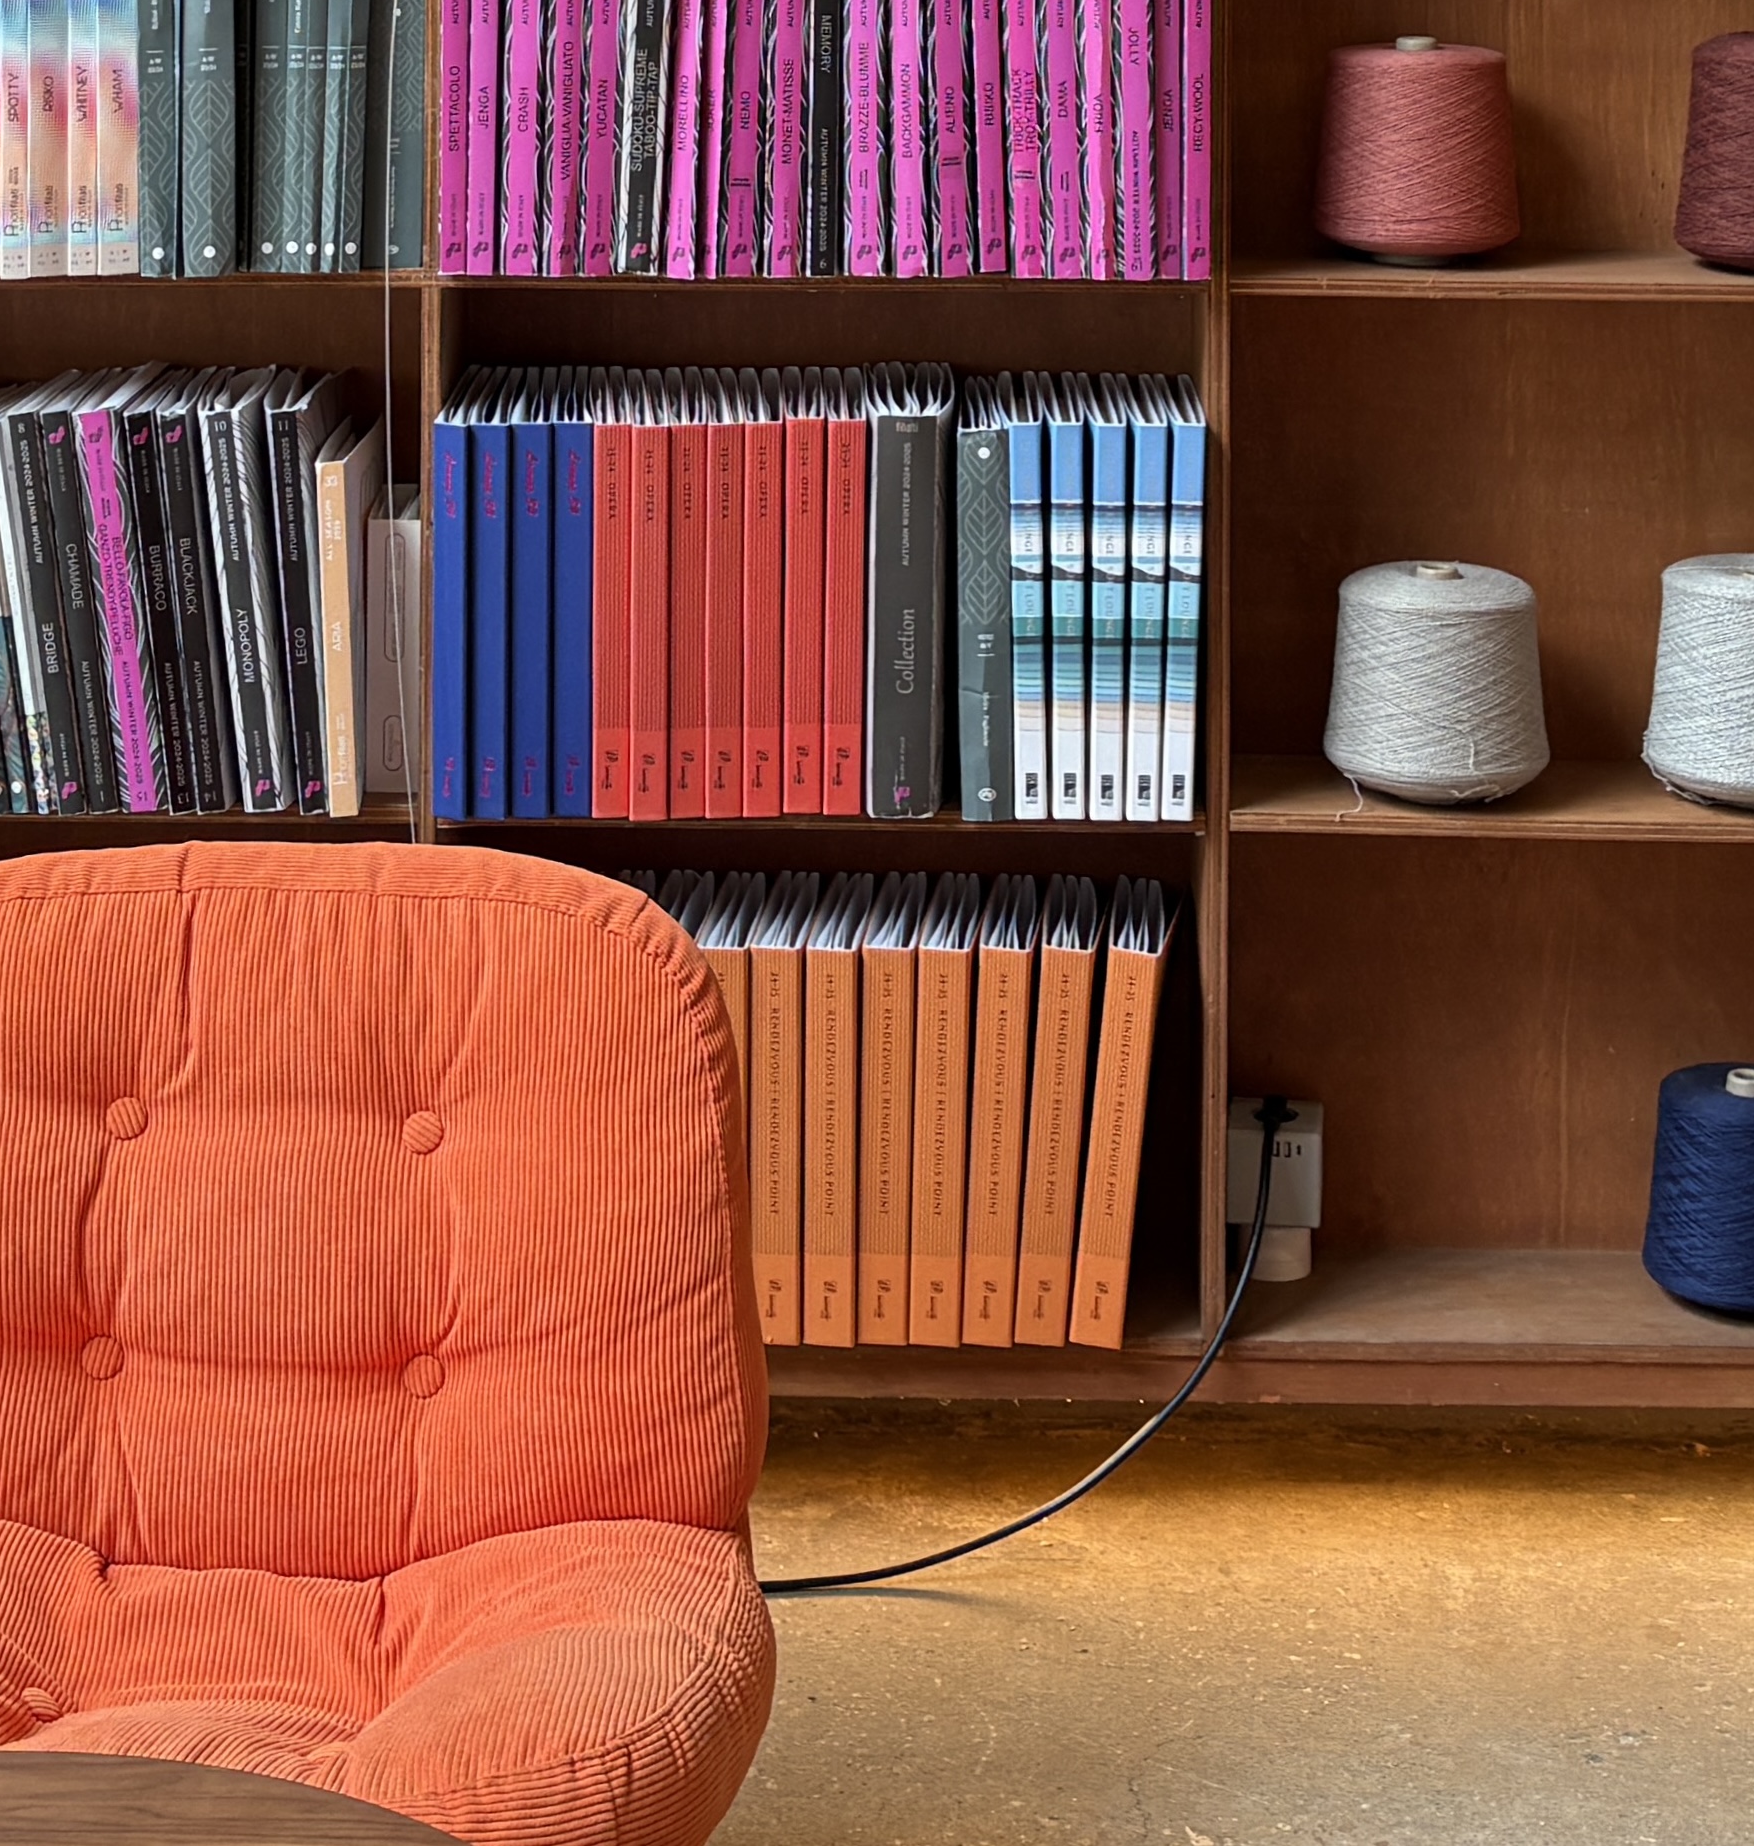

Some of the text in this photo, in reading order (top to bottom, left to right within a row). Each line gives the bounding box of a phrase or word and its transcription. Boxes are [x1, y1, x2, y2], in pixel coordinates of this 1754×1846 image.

[820, 13, 834, 74] MEMORY
[1127, 26, 1141, 67] JOLLY
[42, 75, 54, 113] RISKO
[75, 65, 89, 123] WHITNEY
[448, 65, 461, 153] SPETTACOLO
[476, 85, 491, 130] JENGA
[560, 40, 576, 181] VANIGLIA-VANIGLIATO
[630, 48, 649, 172] SUDOKU-SUPREME
[643, 61, 659, 159] TABOO-TIP-TAP
[676, 74, 690, 152] MORELLINO
[738, 90, 752, 130] NEMO
[780, 58, 795, 165] MONET-MATISSE
[857, 41, 872, 154] BRAZZE-BLUMME
[899, 62, 914, 159] BACKGAMMON
[1056, 80, 1070, 119] DAMA
[1191, 73, 1205, 152] RECY-WOOL
[26, 487, 41, 527] WINTER
[901, 491, 911, 526] WINTER
[33, 525, 45, 565] AUTUMN
[901, 527, 911, 566] AUTUMN
[65, 542, 85, 610] CHAMADE
[149, 544, 168, 611] BURRACO
[179, 536, 199, 616] BLACKJACK
[41, 622, 60, 674] BRIDGE
[235, 607, 256, 683] MONOPOLY
[292, 626, 309, 665] LEGO
[330, 620, 344, 652] ARIA
[894, 608, 917, 695] Collection
[931, 1181, 944, 1217] POINT
